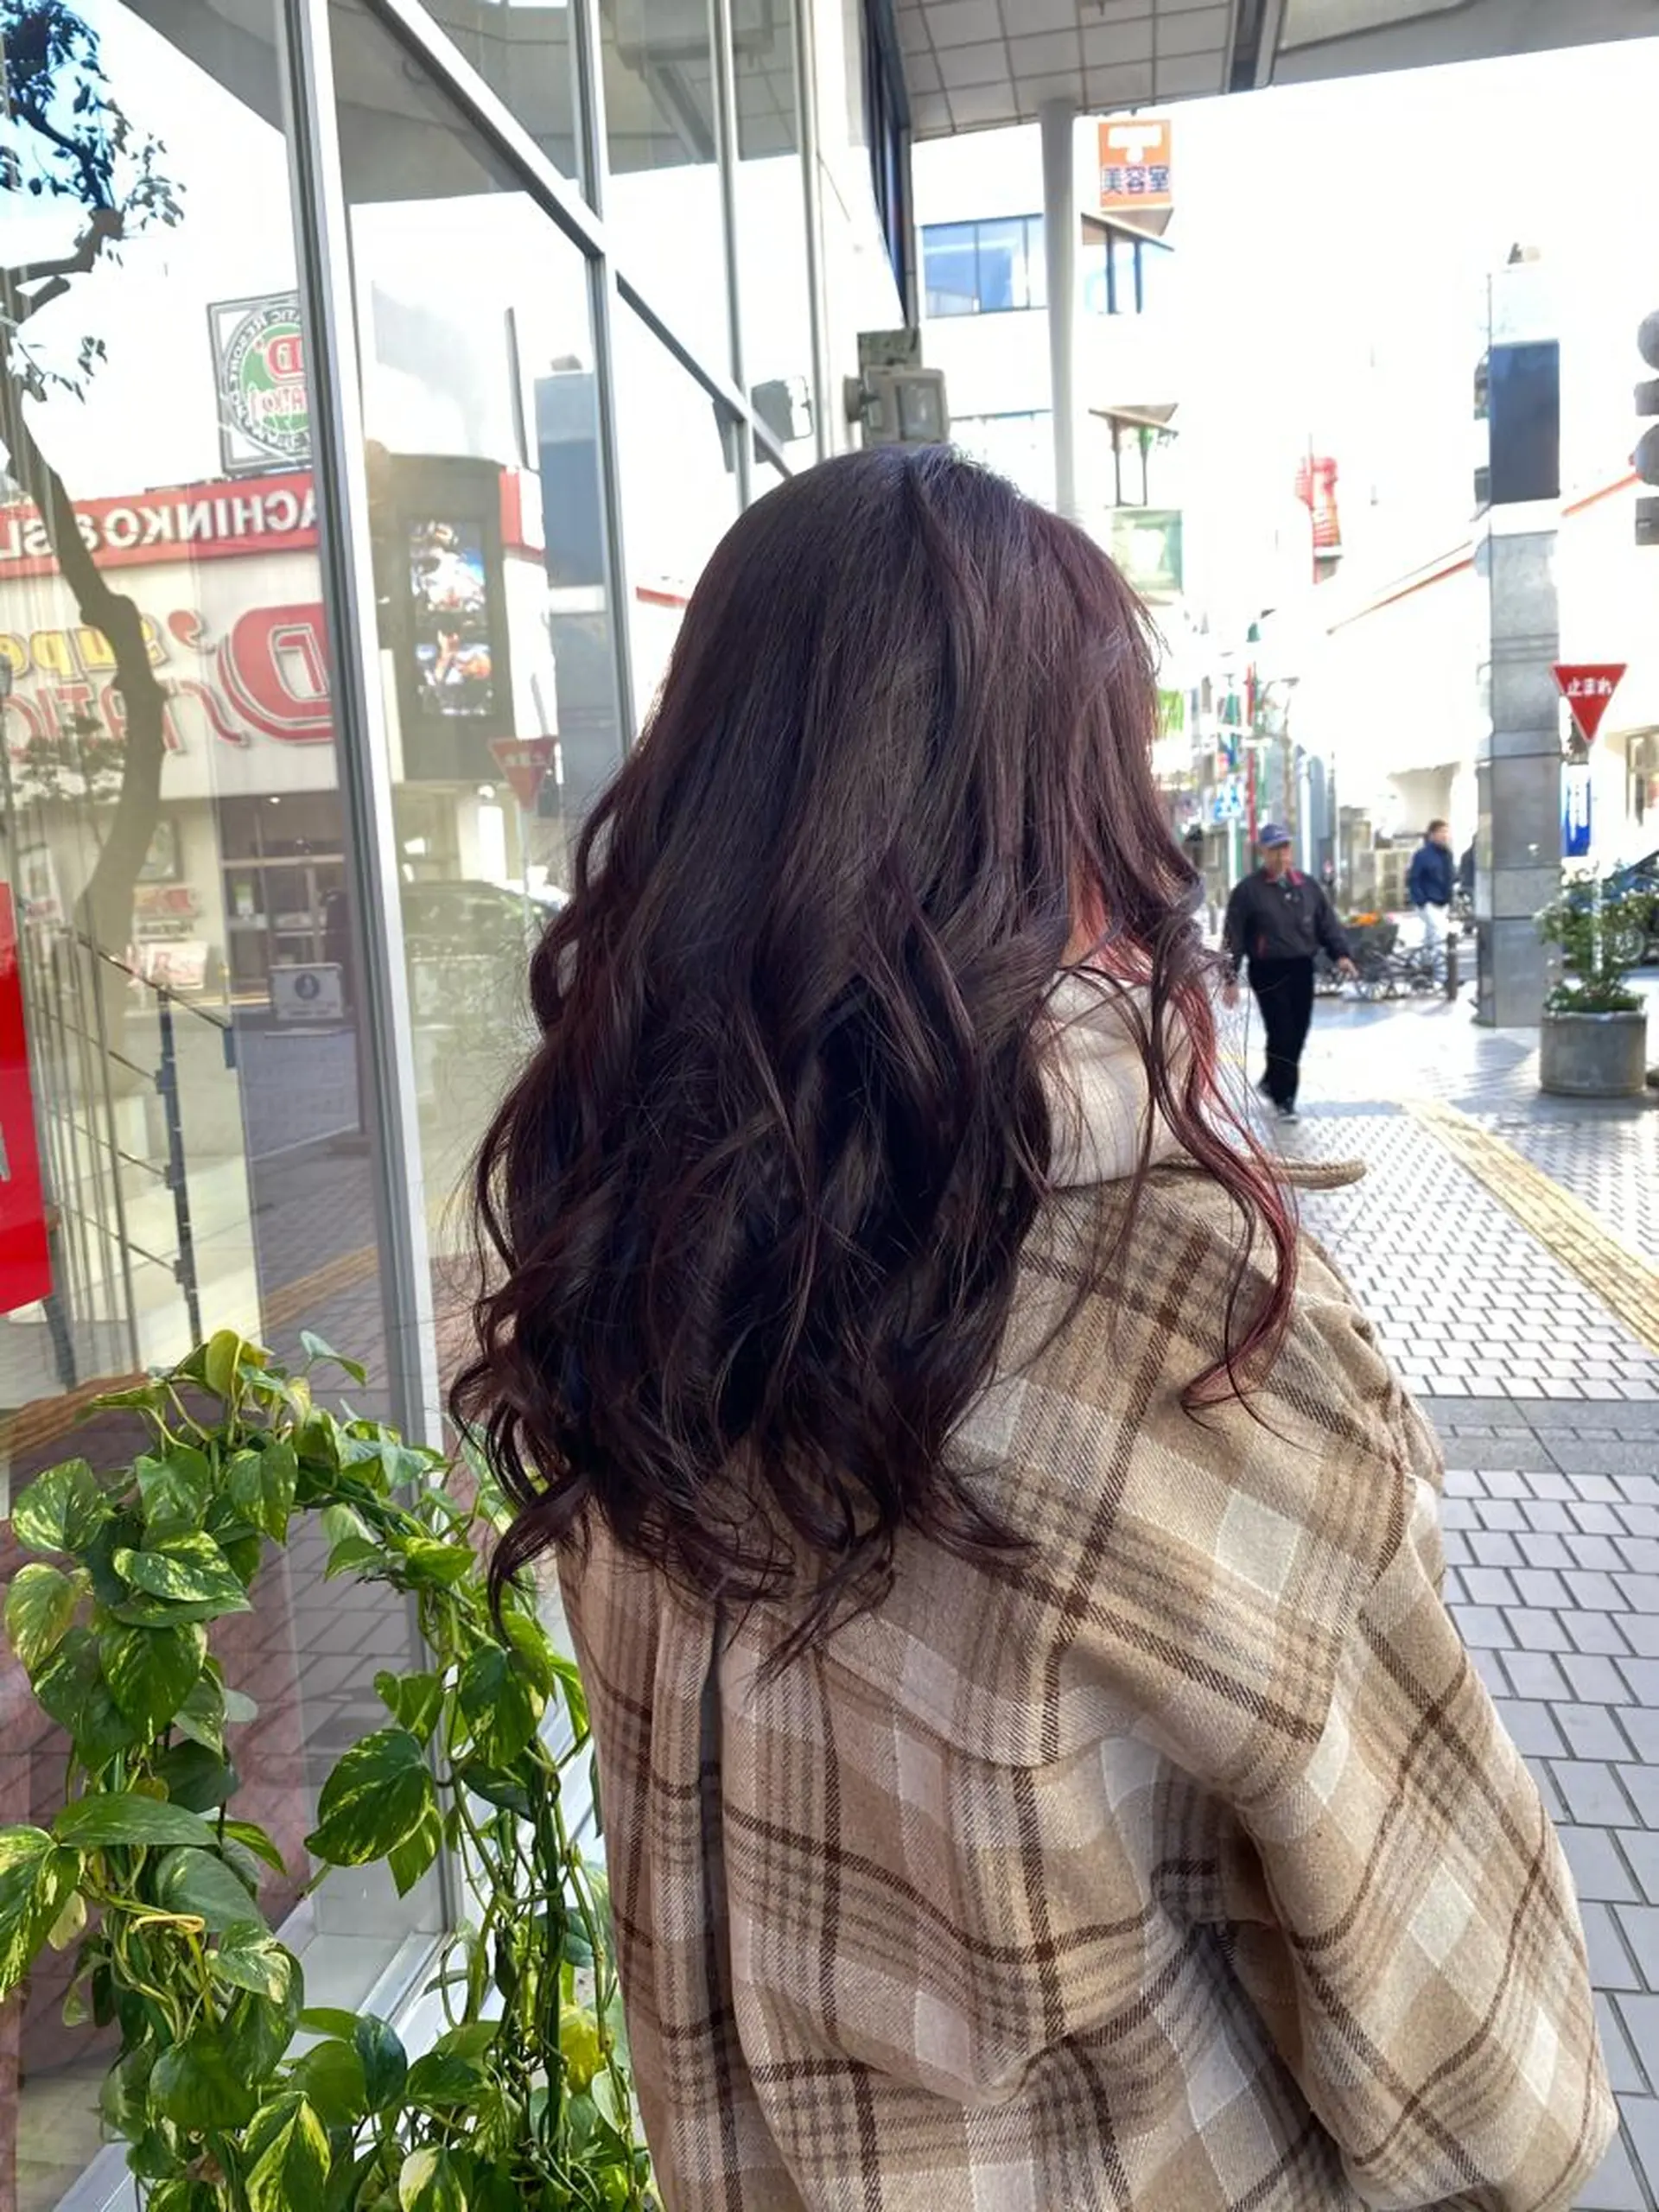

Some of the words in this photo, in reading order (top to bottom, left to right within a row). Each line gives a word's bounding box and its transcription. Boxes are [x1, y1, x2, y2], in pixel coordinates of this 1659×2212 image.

[1102, 166, 1169, 194] 美容室
[1567, 677, 1612, 696] 止まれ
